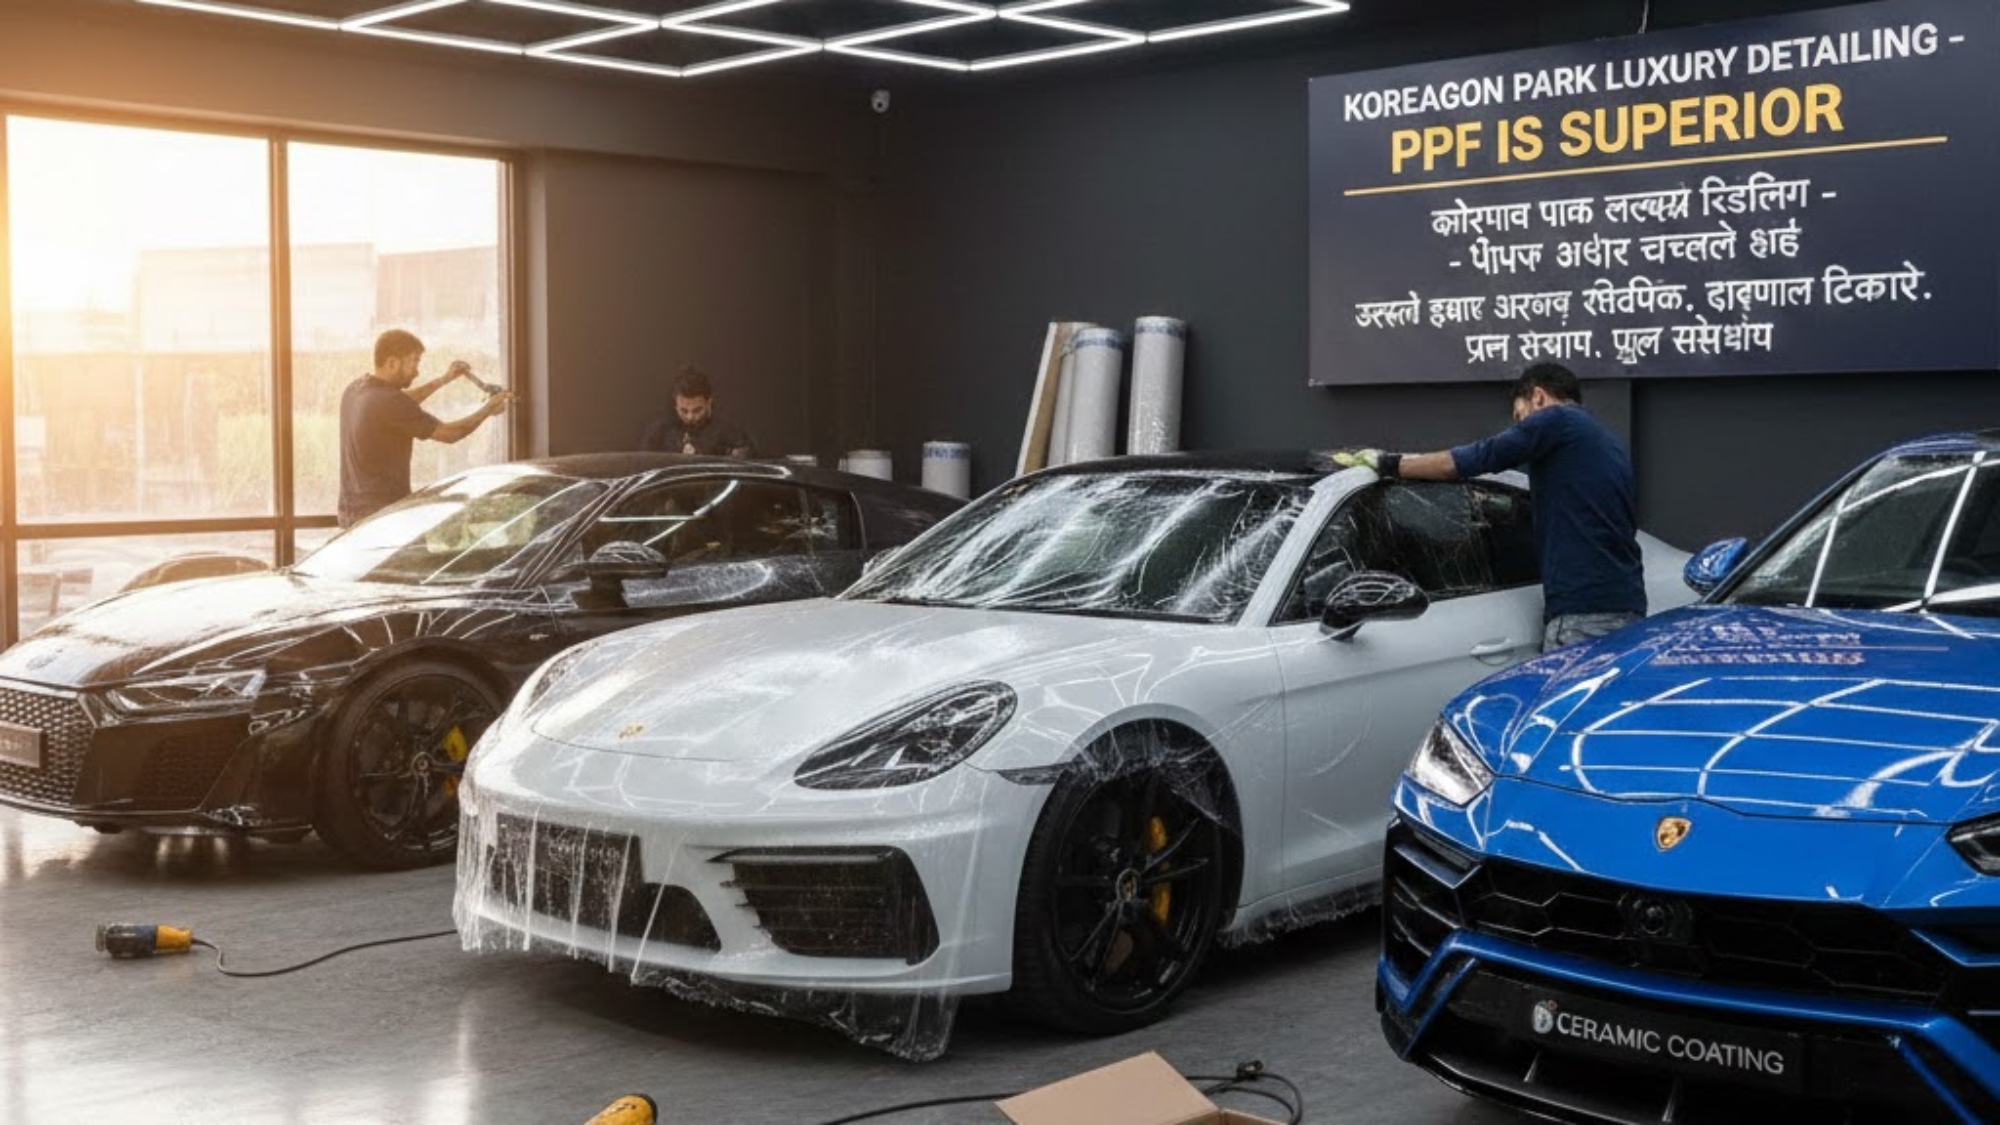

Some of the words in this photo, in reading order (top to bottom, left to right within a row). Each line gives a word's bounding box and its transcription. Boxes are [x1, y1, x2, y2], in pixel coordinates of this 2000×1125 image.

[1343, 75, 1506, 124] KOREAGON
[1512, 63, 1598, 102] PARK
[1605, 45, 1739, 91] LUXURY
[1747, 22, 1939, 75] DETAILING
[1391, 120, 1483, 174] PPF
[1497, 115, 1544, 164] IS
[1559, 82, 1845, 157] SUPERIOR
[1556, 1012, 1661, 1053] CERAMIC
[1667, 1034, 1784, 1074] COATING
